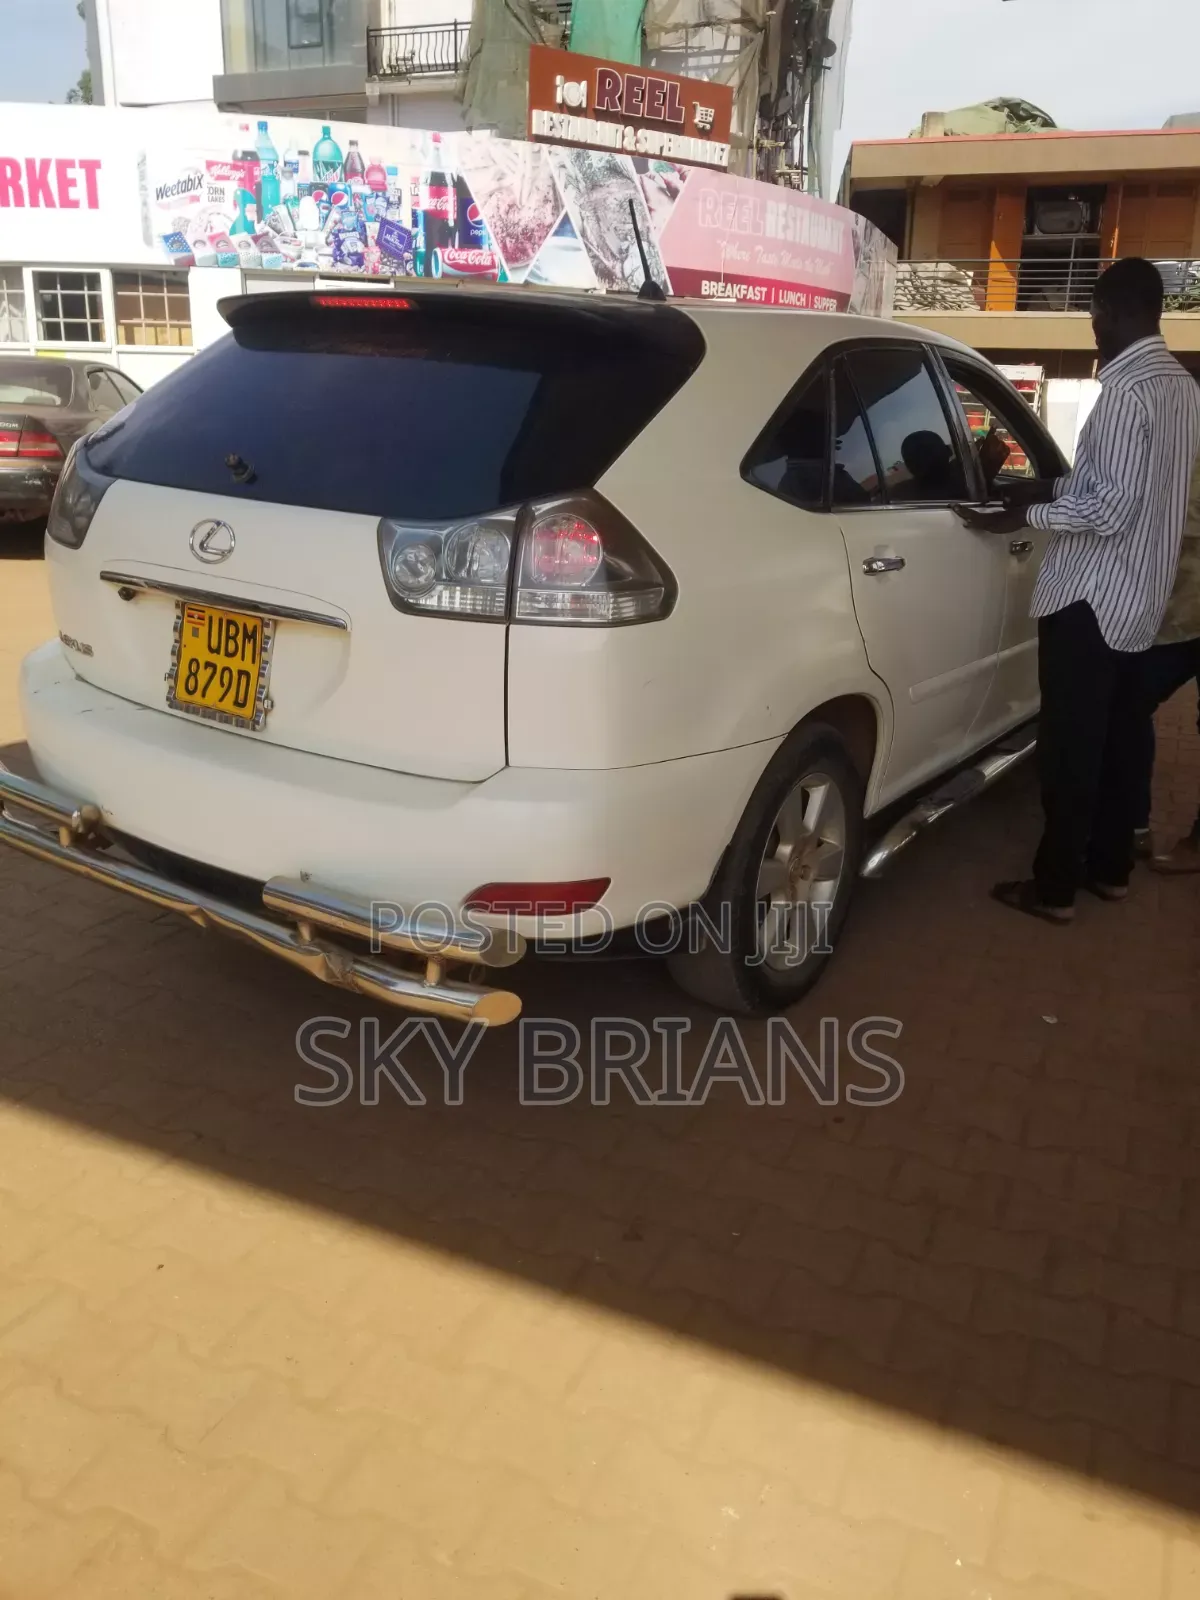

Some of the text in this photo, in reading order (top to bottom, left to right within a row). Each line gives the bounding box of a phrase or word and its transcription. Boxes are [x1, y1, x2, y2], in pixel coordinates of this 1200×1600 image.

[595, 67, 685, 123] REEL
[0, 157, 101, 209] RKET
[155, 172, 204, 201] Weetabix
[699, 188, 847, 255] REEL RESTAURANT
[701, 280, 837, 312] BREAKFAST LUNCH SUPPER
[207, 615, 258, 664] UBM
[184, 658, 252, 709] 879D
